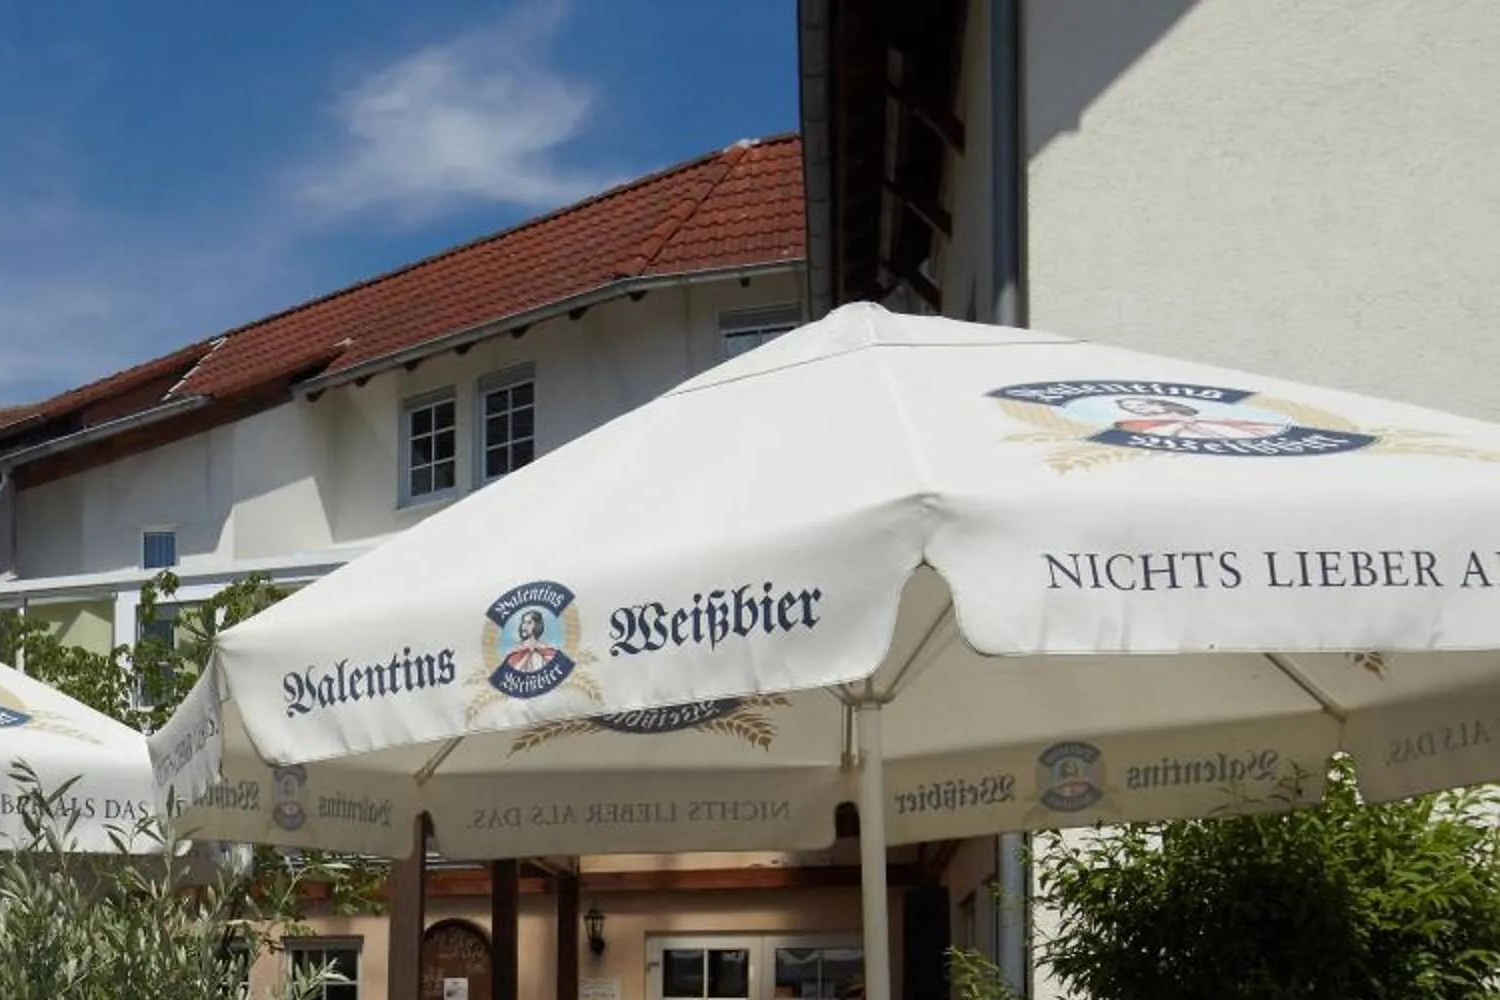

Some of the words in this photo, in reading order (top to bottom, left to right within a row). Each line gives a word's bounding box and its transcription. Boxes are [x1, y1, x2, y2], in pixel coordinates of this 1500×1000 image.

[1043, 550, 1243, 591] NICHTS
[1263, 550, 1445, 589] LIEBER
[283, 646, 456, 719] Valentins
[610, 581, 823, 658] Weißbier
